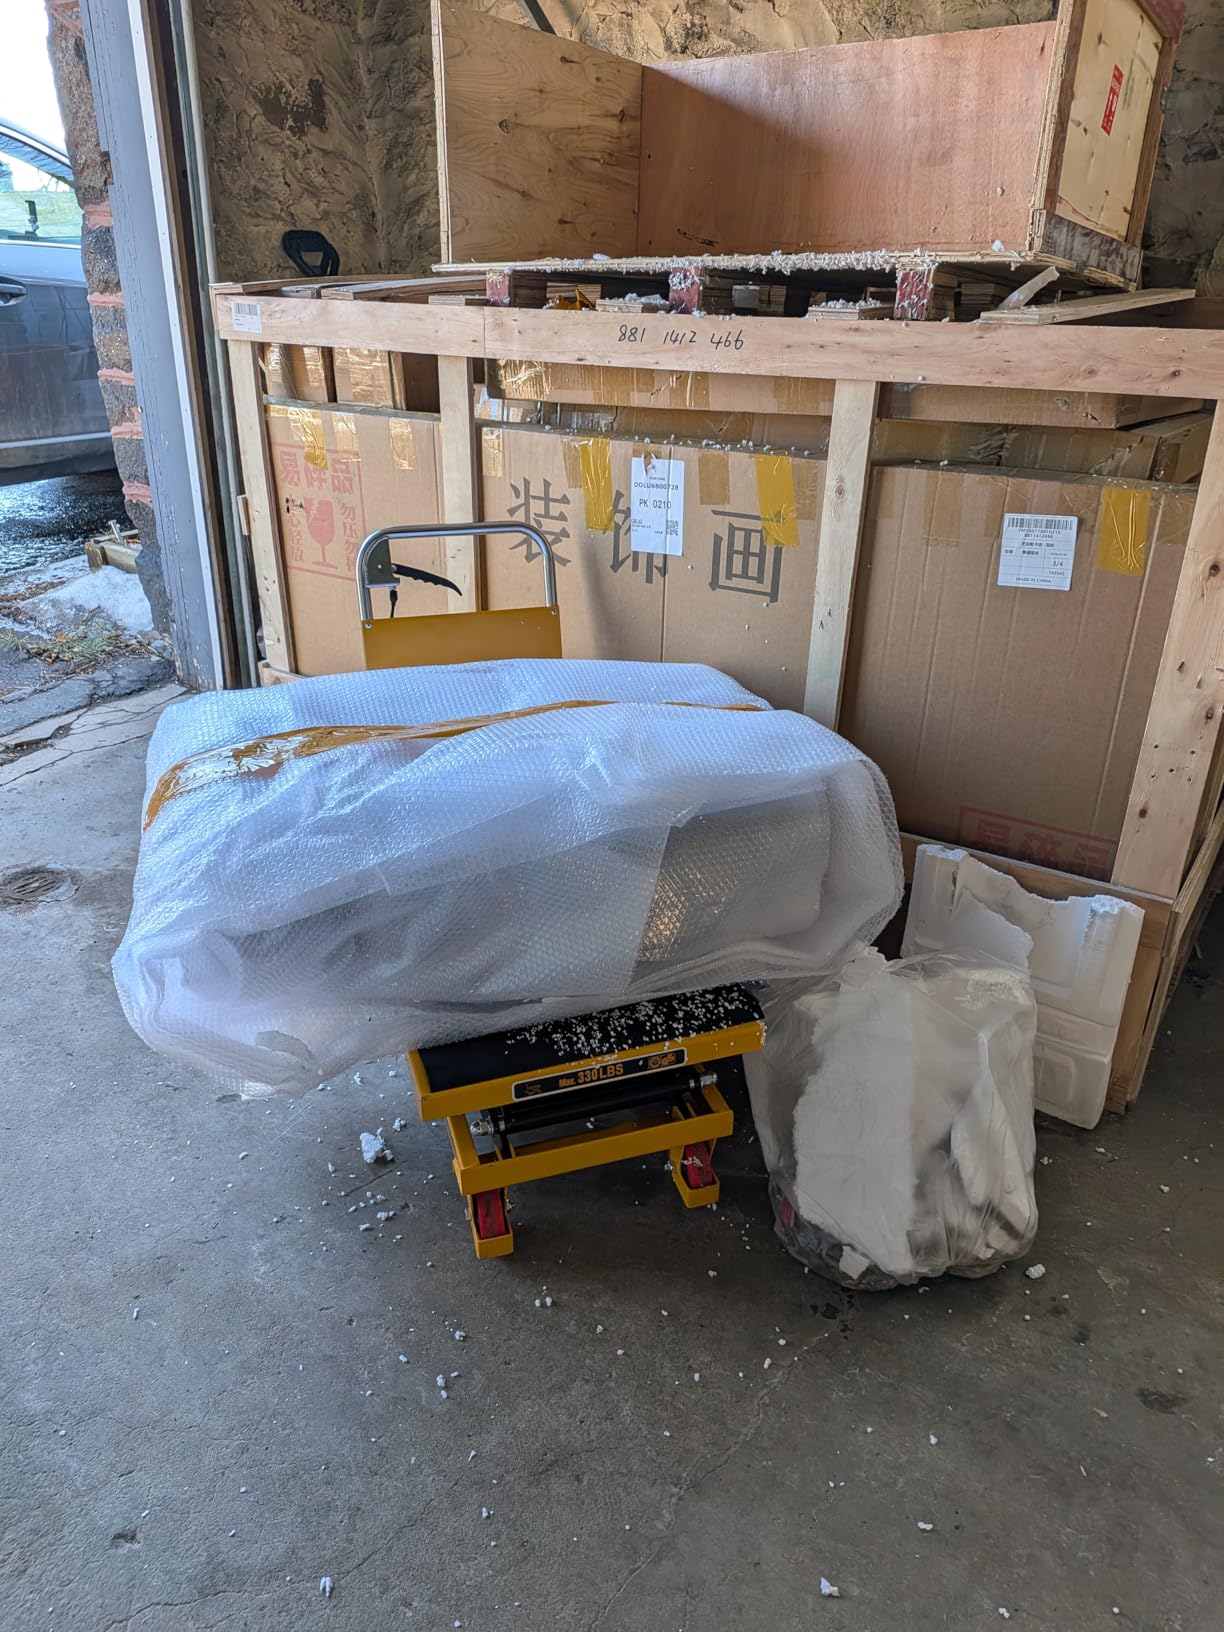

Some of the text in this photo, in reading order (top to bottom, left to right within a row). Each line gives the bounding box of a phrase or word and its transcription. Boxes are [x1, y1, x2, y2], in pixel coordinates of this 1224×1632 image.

[618, 324, 744, 350] 881 1412 466
[639, 498, 672, 510] PK 0210
